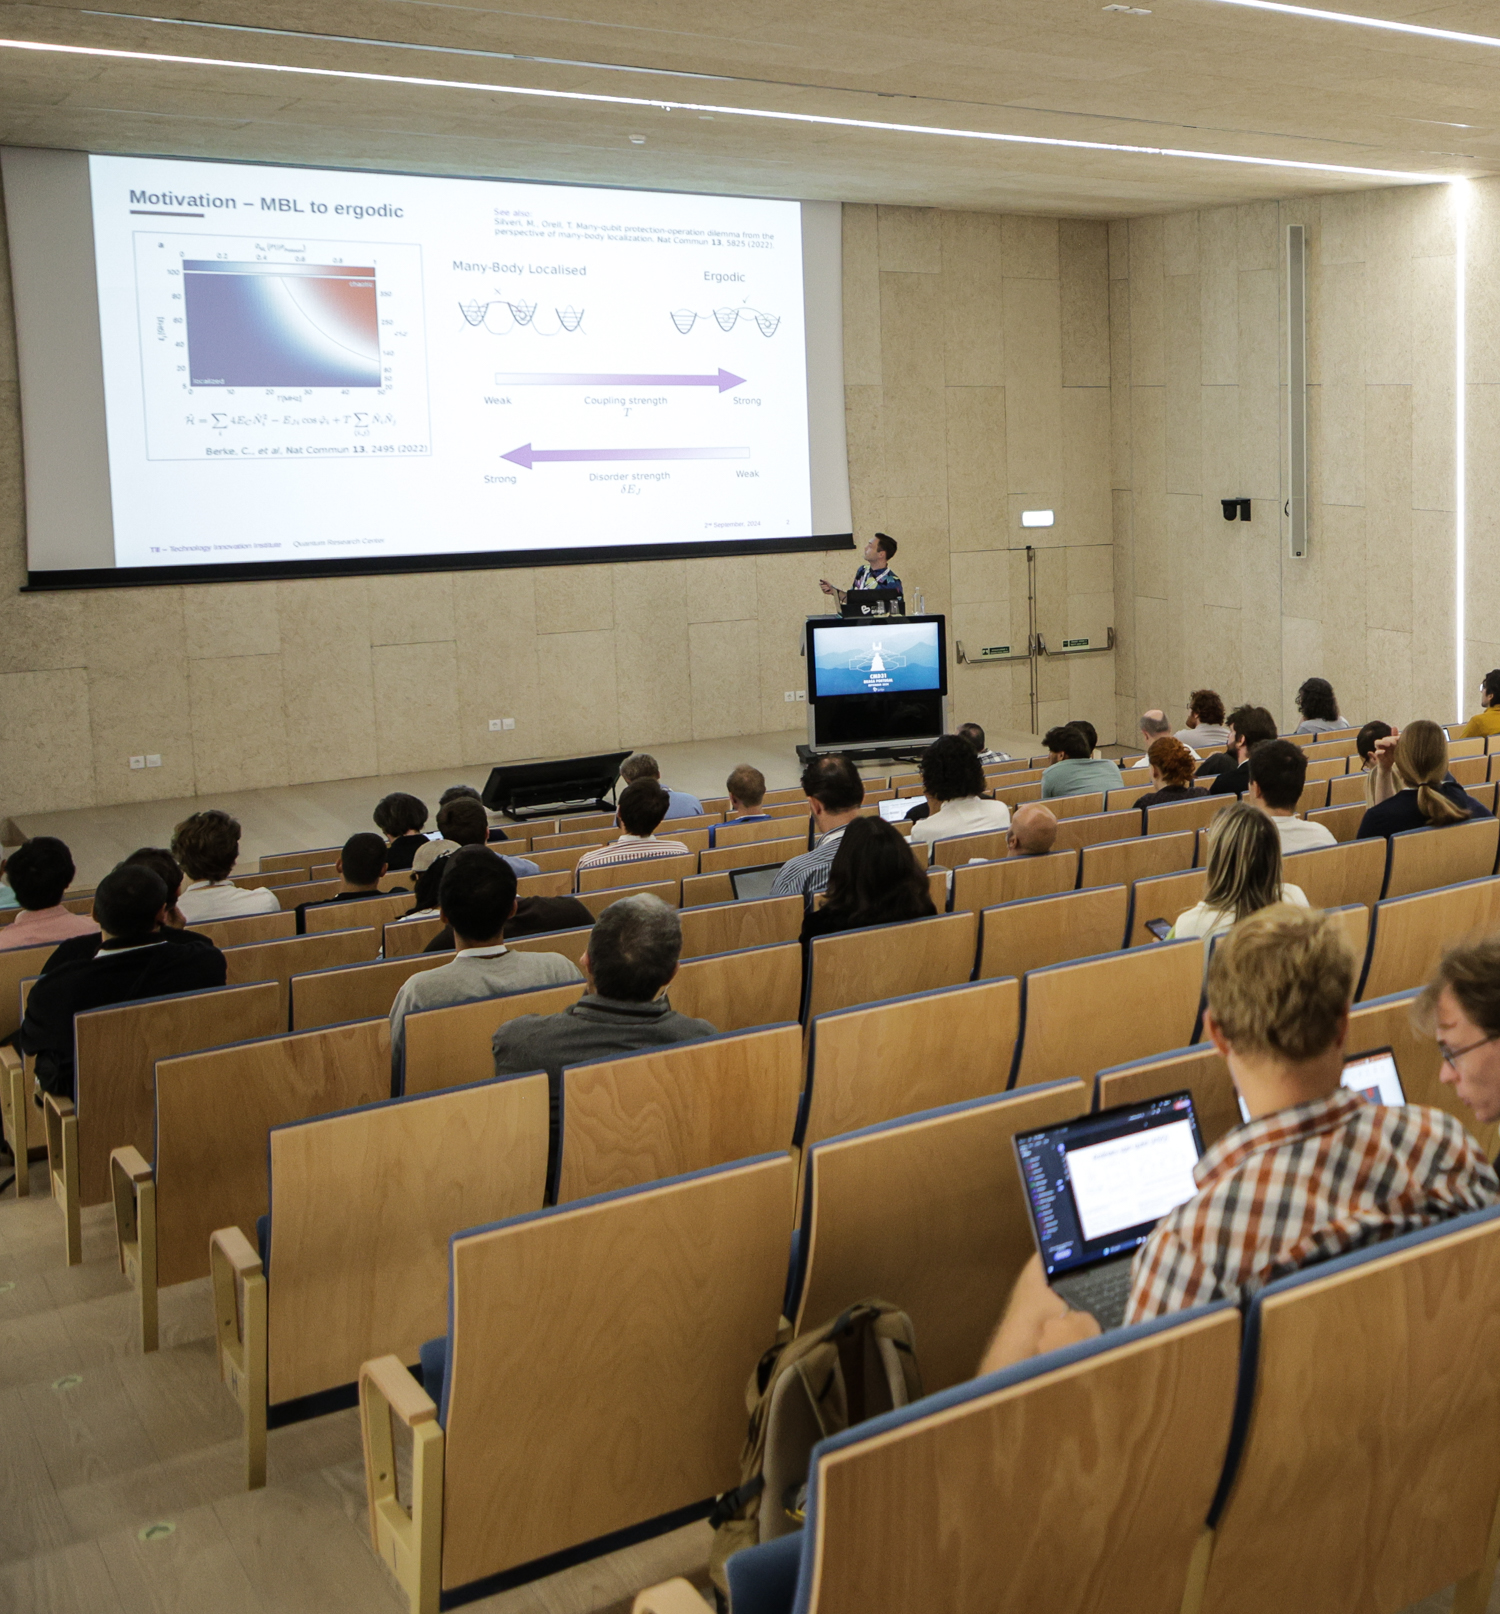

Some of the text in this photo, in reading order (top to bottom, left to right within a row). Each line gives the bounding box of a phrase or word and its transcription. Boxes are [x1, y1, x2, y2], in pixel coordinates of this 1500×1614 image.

[129, 189, 237, 209] Motivation
[260, 197, 305, 213] MBL
[310, 201, 328, 214] to
[334, 203, 404, 219] ergodic
[493, 208, 510, 216] See
[576, 221, 622, 233] Many-qubit
[707, 229, 740, 238] dilemma
[742, 231, 760, 240] from
[494, 228, 545, 238] perspective
[547, 230, 556, 238] of
[558, 230, 604, 241] many-body
[657, 236, 671, 244] Nat
[673, 237, 709, 245] Commun
[726, 240, 746, 248] 5825
[452, 260, 587, 276] Many-Body Localised
[703, 270, 746, 284] Ergodic
[484, 396, 512, 405] Weak
[584, 396, 668, 406] Coupling strength
[733, 396, 762, 406] Strong
[258, 447, 268, 455] et
[286, 446, 303, 454] Nat
[306, 446, 350, 454] Commun
[371, 445, 395, 453] 2495
[397, 444, 428, 453] (2022)
[589, 471, 671, 482] Disorder strength
[736, 470, 760, 478] Weak
[484, 475, 517, 485] Strong
